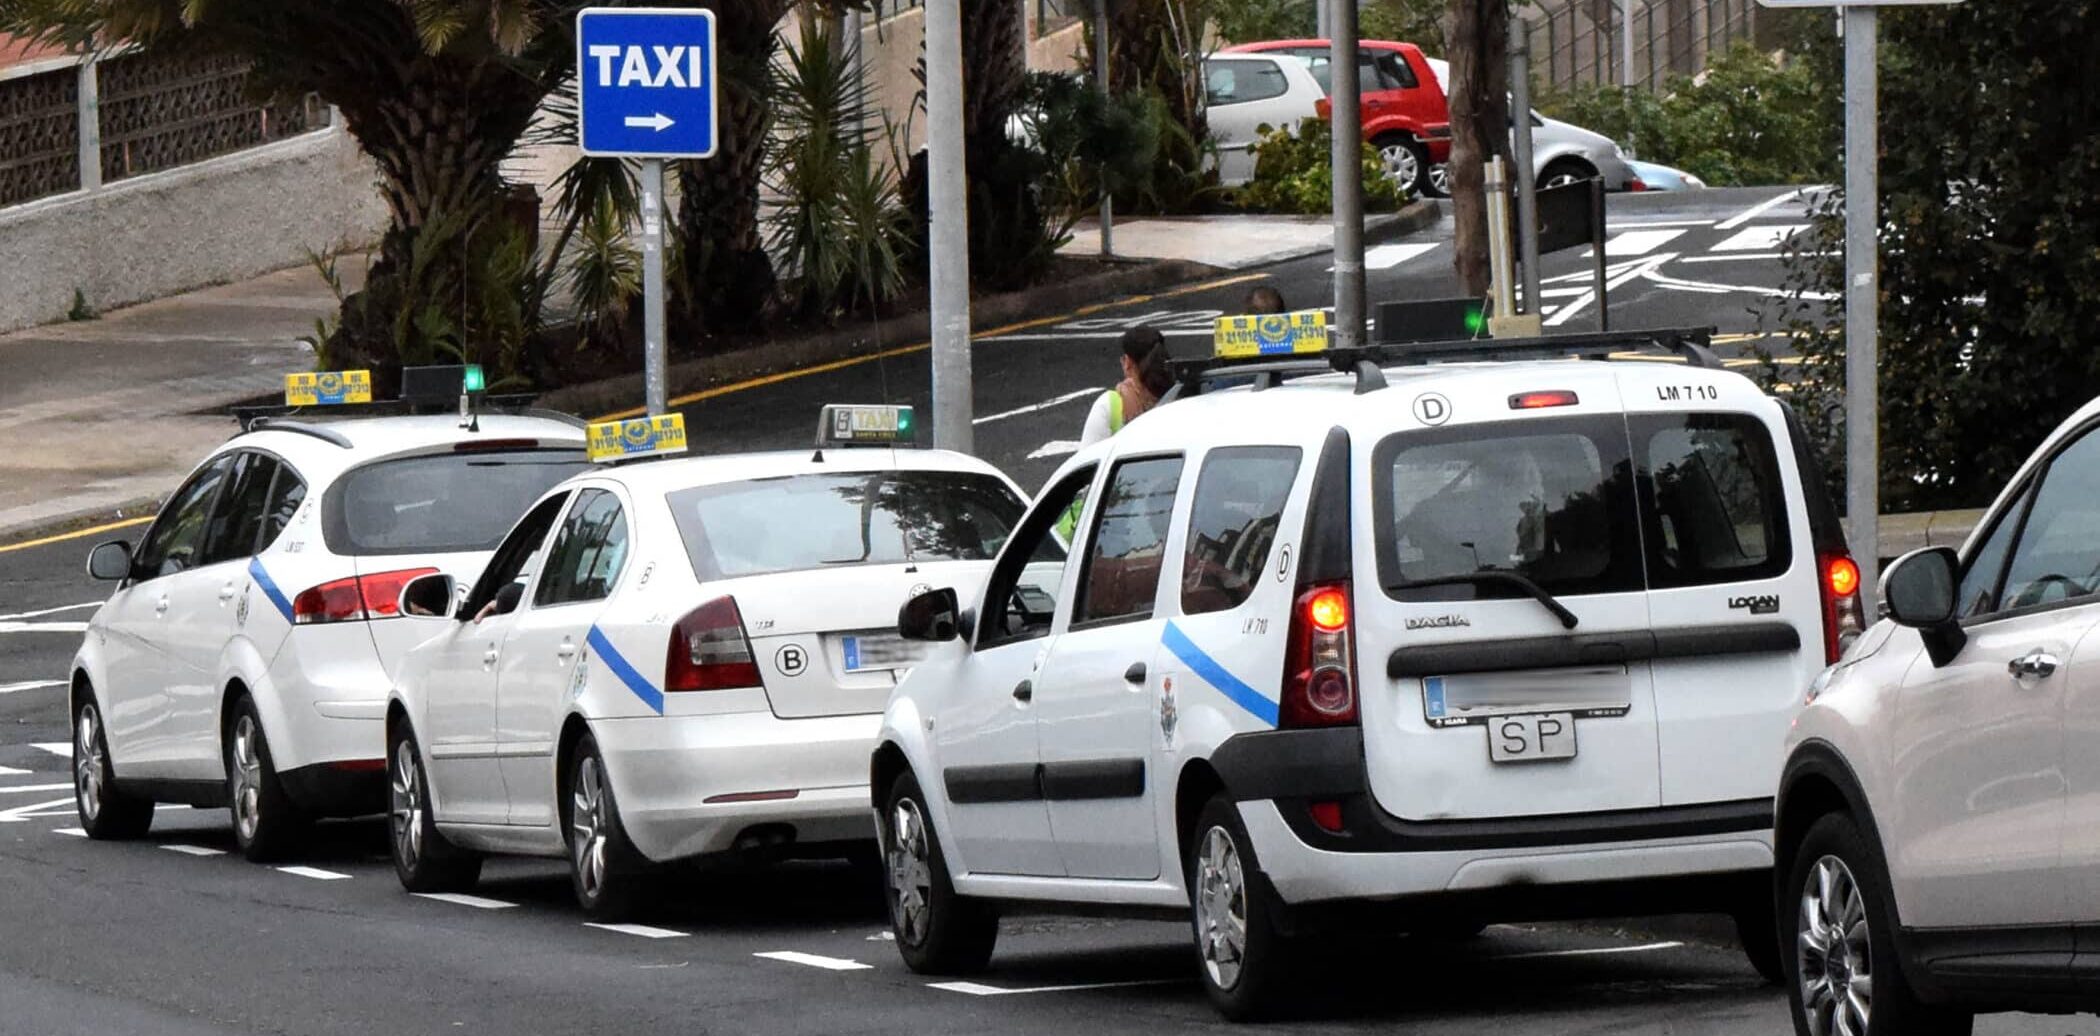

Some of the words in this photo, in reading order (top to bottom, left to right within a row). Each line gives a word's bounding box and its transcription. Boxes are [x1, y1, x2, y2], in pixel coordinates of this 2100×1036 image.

[589, 45, 701, 88] TAXI
[1656, 385, 1680, 400] LM
[1683, 385, 1718, 400] 710
[1422, 398, 1443, 419] D
[1728, 594, 1779, 609] LOGAN
[1405, 615, 1471, 630] DACIA
[784, 649, 802, 670] B
